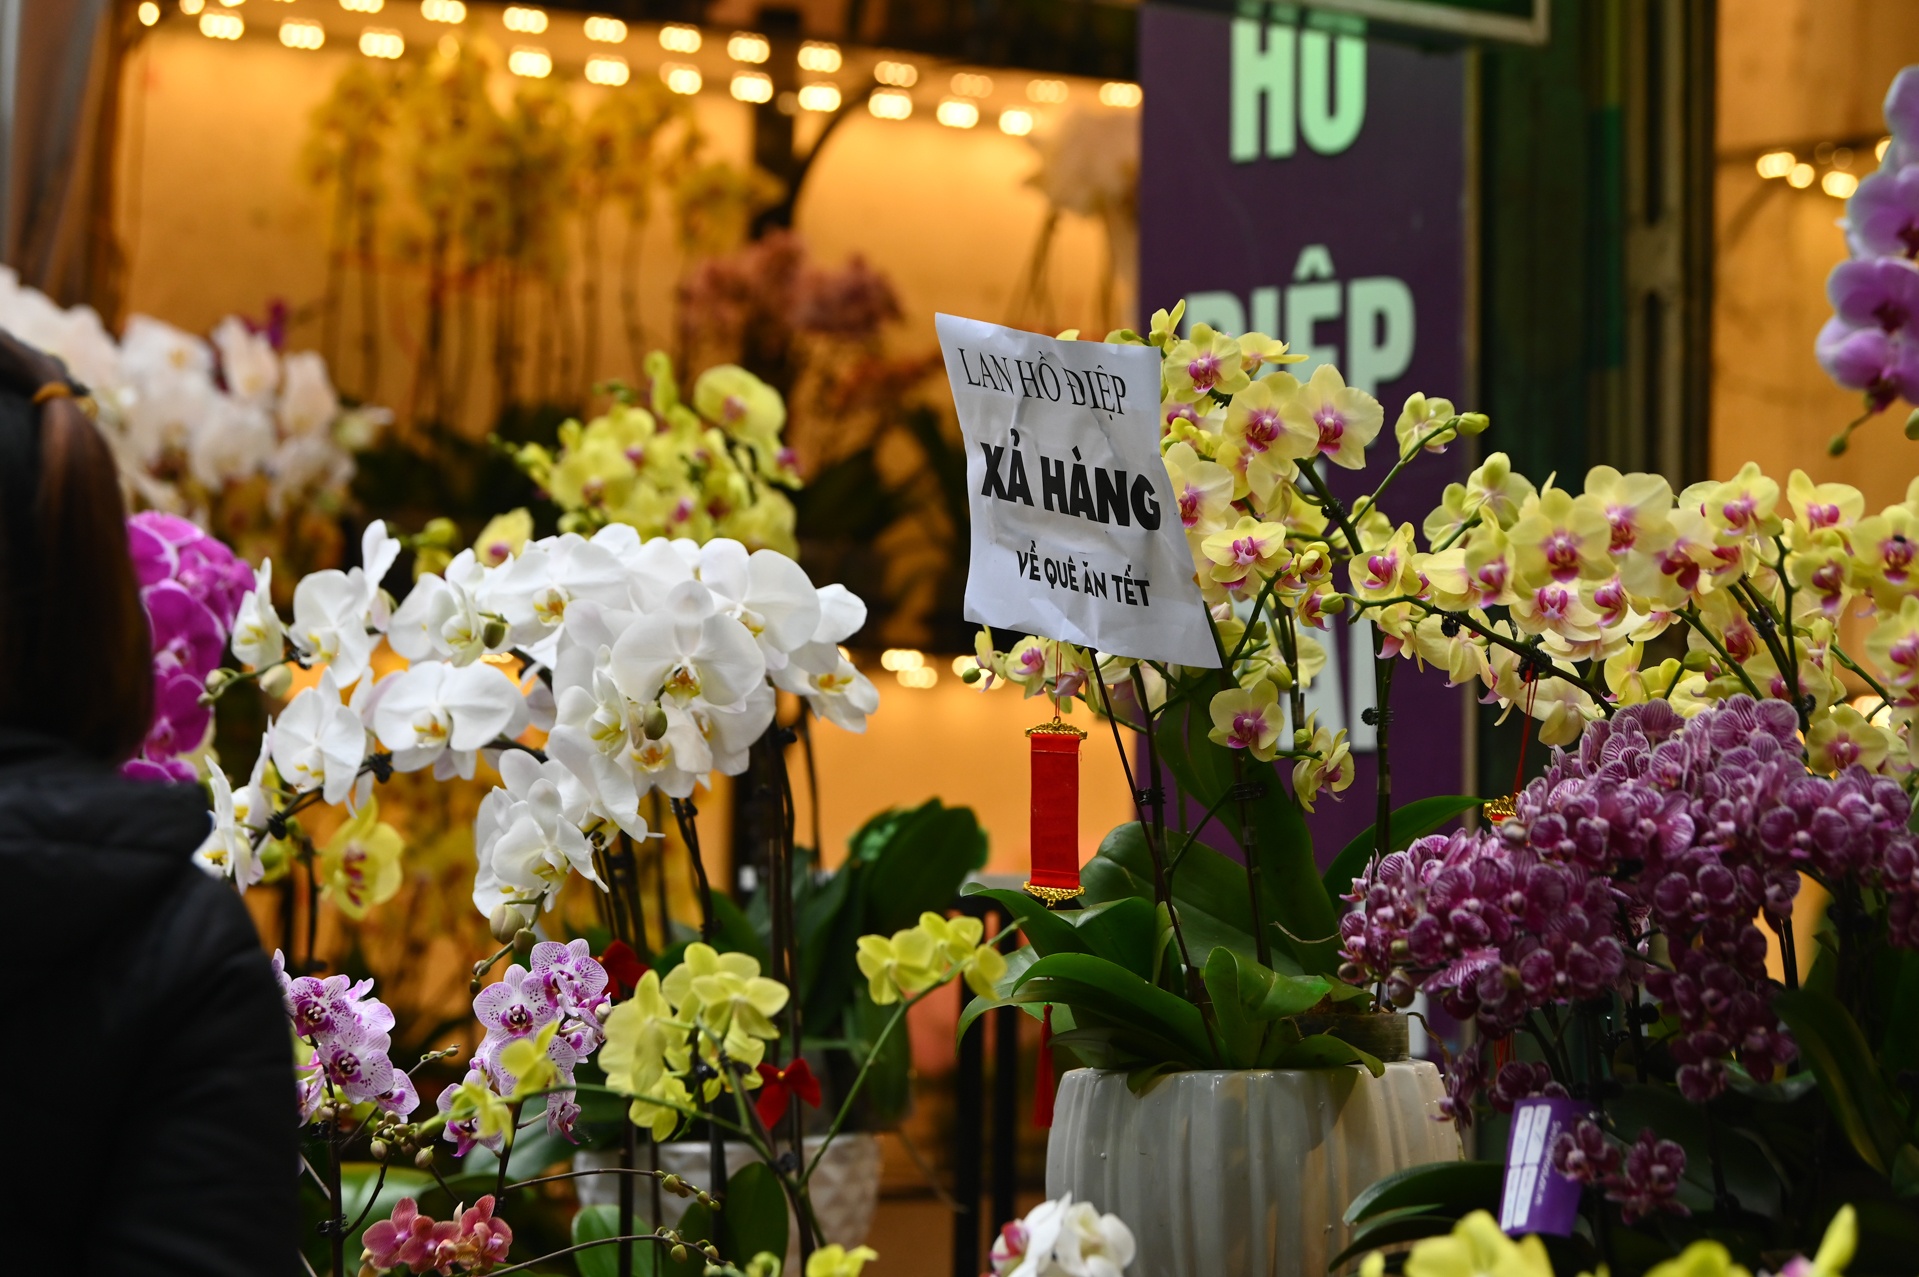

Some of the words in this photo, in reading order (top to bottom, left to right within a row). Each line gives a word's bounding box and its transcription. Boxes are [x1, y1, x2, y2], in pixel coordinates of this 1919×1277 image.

[957, 347, 1015, 396] LAN
[1013, 351, 1062, 403] HỒ
[1061, 364, 1128, 421] ĐIỆP
[979, 427, 1035, 508] XẢ
[1039, 445, 1162, 532] HÀNG
[1015, 539, 1042, 582] VỀ
[1043, 555, 1080, 593] QUÊ
[1082, 560, 1109, 601] ĂN
[1111, 563, 1151, 607] TẾT
